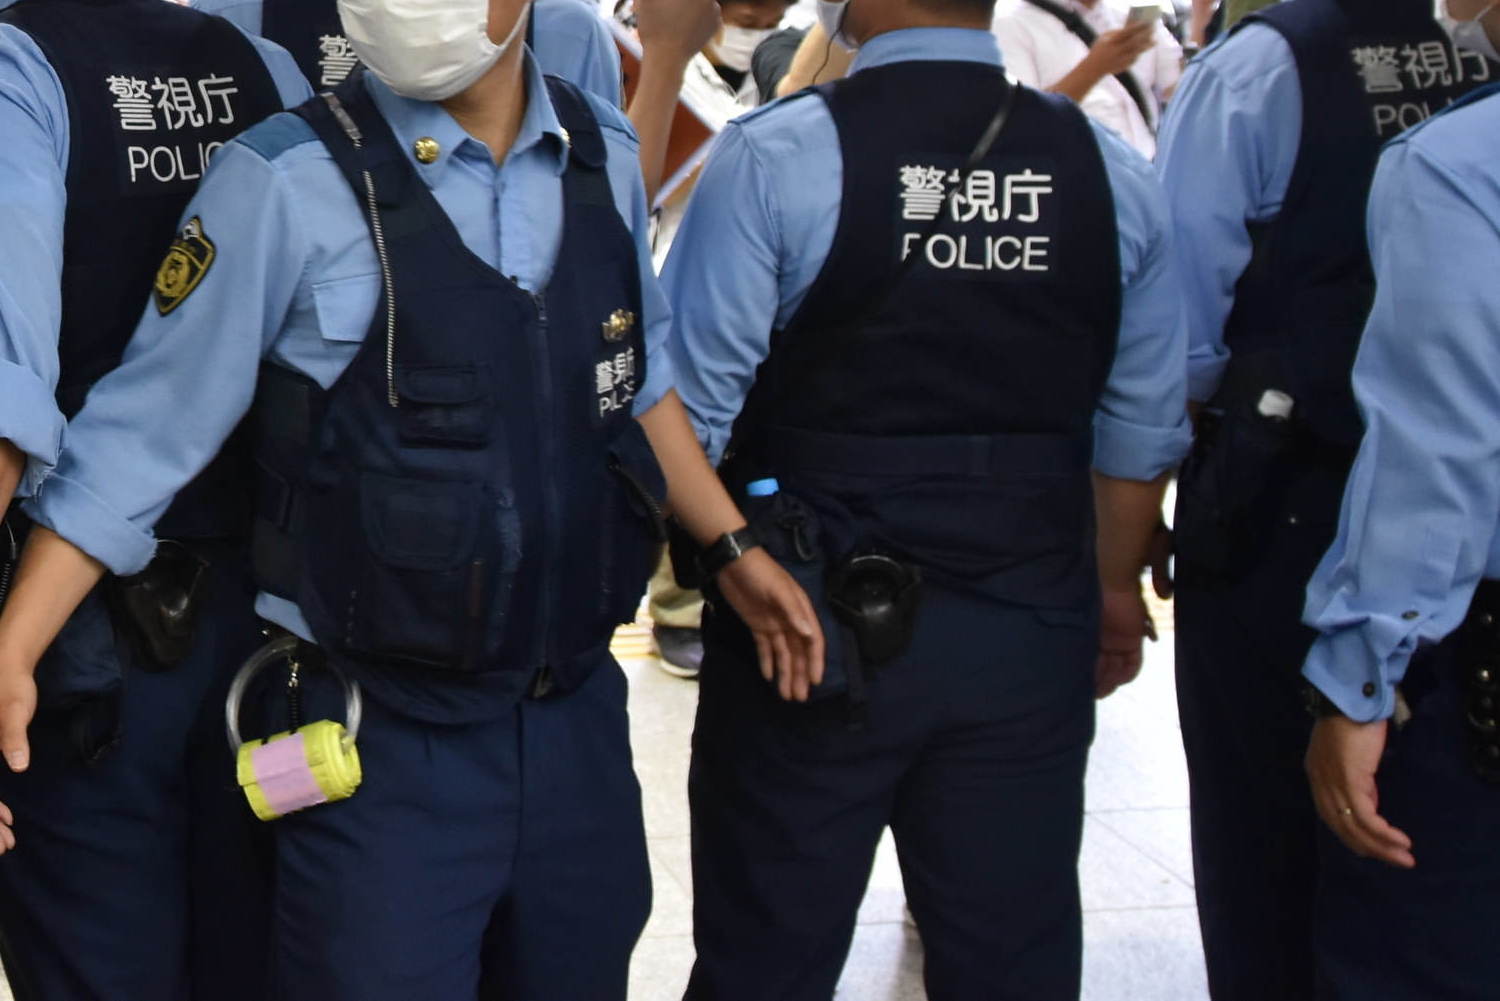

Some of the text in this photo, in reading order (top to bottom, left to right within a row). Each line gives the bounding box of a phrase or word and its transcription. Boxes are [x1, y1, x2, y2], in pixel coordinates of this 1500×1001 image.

[1351, 41, 1490, 94] 警視庁
[106, 73, 239, 131] 警視庁
[899, 164, 1053, 222] 警視庁
